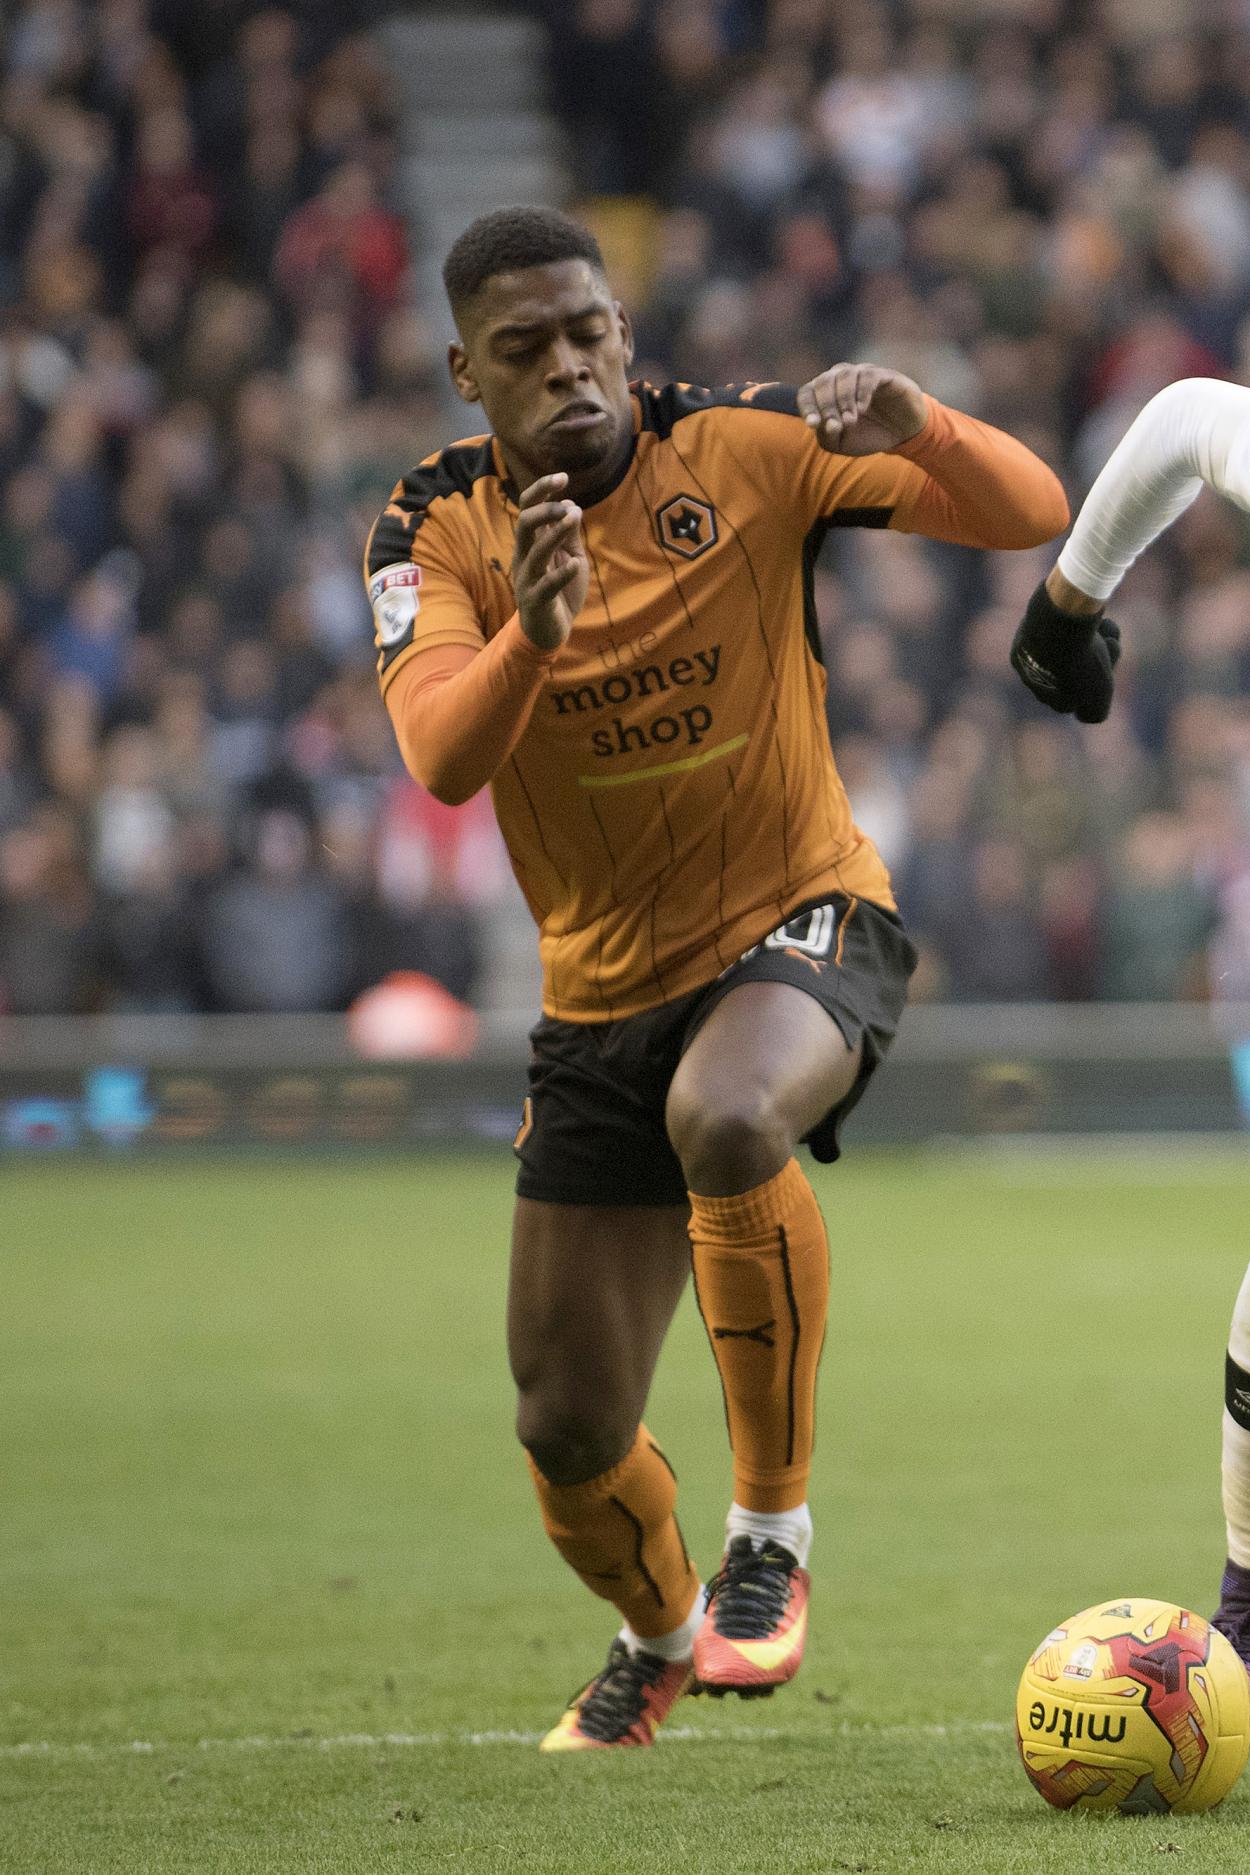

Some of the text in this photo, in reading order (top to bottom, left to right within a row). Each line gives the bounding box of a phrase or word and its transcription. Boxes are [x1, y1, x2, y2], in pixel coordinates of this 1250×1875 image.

[386, 570, 416, 587] BET
[596, 632, 657, 669] the
[551, 643, 722, 716] money
[591, 703, 713, 757] shop
[1029, 1701, 1126, 1748] mitre
